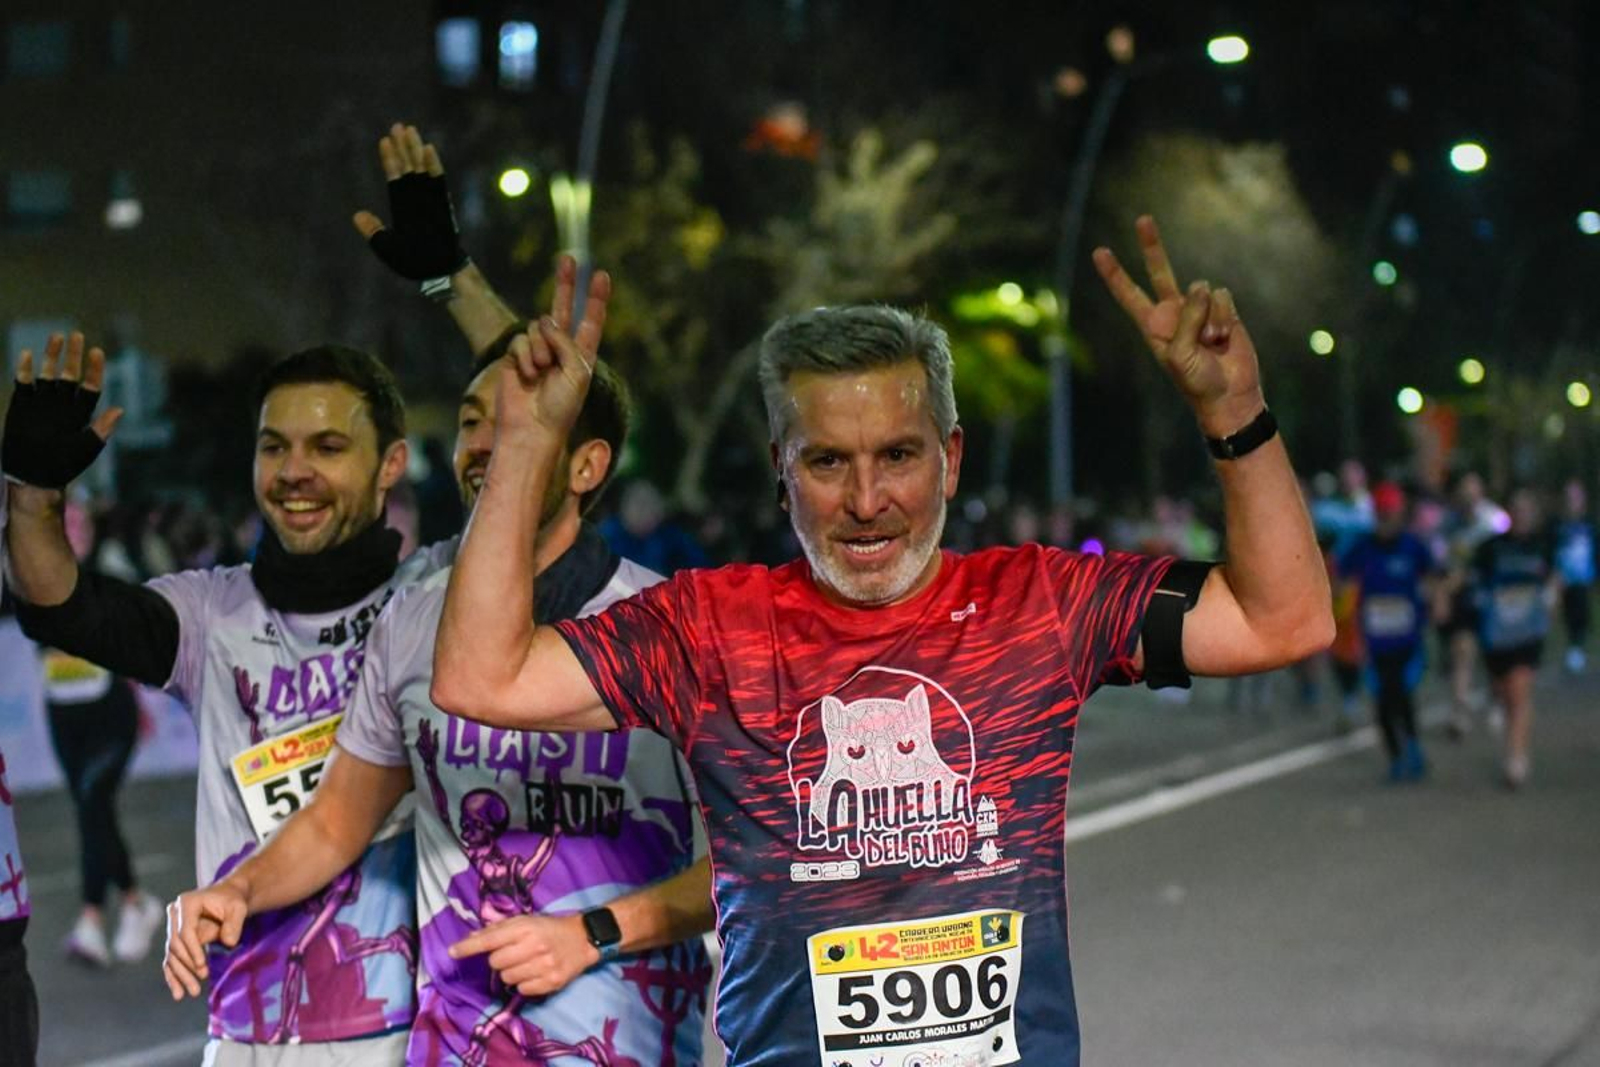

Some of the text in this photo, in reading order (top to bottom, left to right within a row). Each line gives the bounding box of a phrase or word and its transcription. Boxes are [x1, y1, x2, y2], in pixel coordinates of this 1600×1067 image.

[263, 761, 325, 820] 55
[527, 783, 622, 836] RUN
[796, 777, 975, 857] LA HUELLA
[865, 831, 910, 867] DEL
[789, 860, 861, 882] 2023
[859, 933, 899, 961] 42
[901, 943, 929, 957] SAN
[838, 955, 1008, 1029] 5906
[859, 1033, 883, 1044] JUAN
[885, 1029, 921, 1042] CARLOS
[925, 1023, 967, 1038] MORALES
